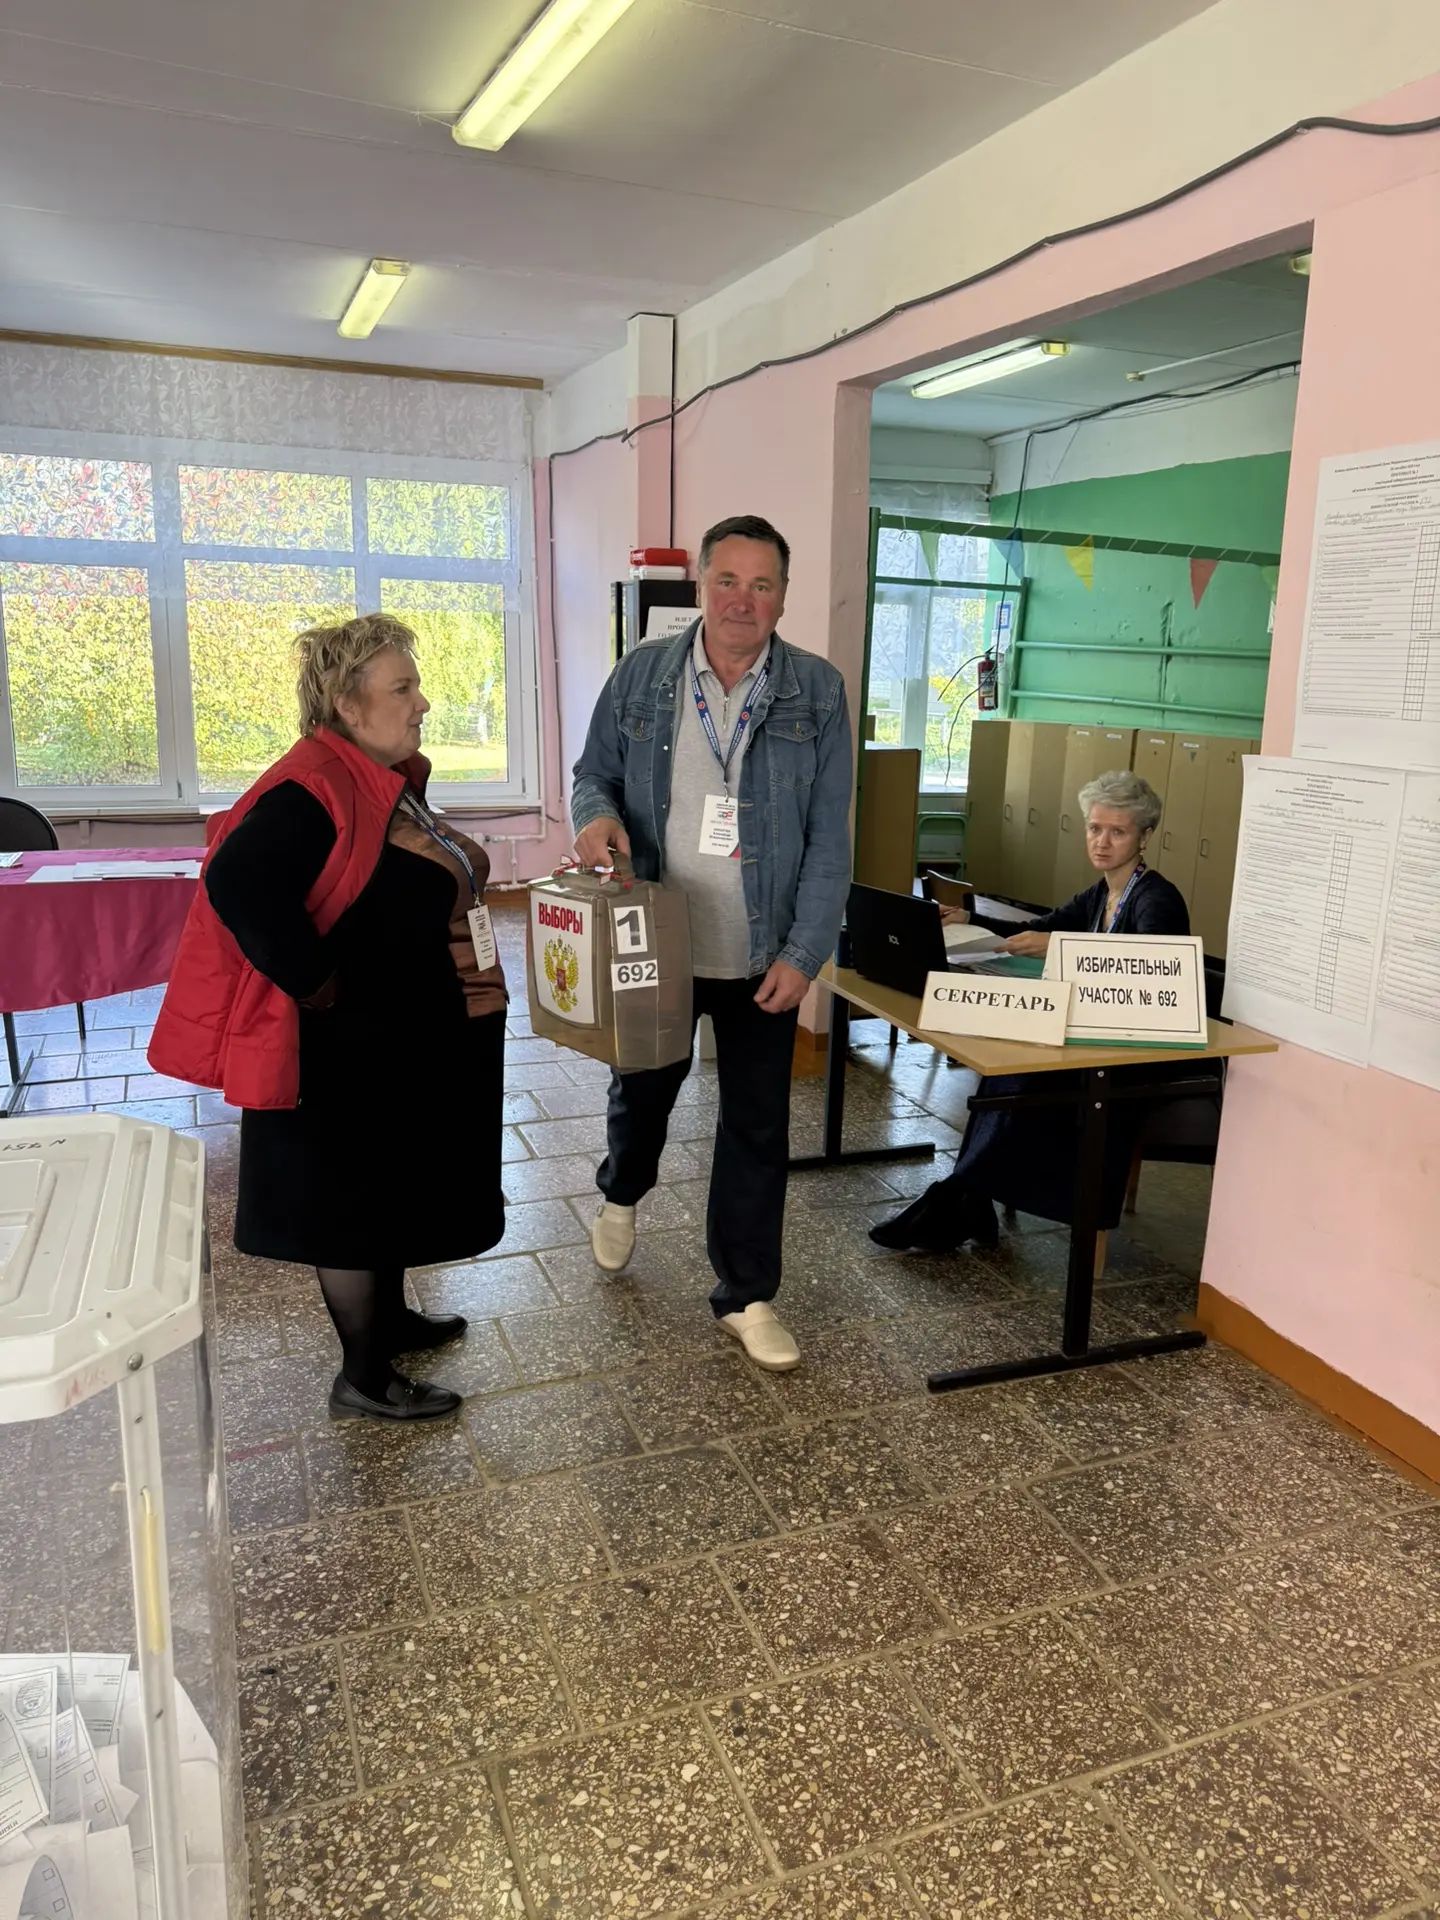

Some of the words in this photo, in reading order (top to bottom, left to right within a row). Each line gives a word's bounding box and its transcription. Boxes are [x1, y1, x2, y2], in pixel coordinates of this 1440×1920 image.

[538, 902, 583, 935] ВЫБОРЫ
[617, 910, 642, 946] 1
[617, 962, 657, 984] 692
[1076, 955, 1182, 976] ИЗБИРАТЕЛЬНЫЙ
[933, 987, 1056, 1012] СЕКРЕТАРЬ
[1078, 986, 1133, 1006] УЧАСТОК
[1139, 989, 1152, 1006] №
[1158, 990, 1178, 1007] 692
